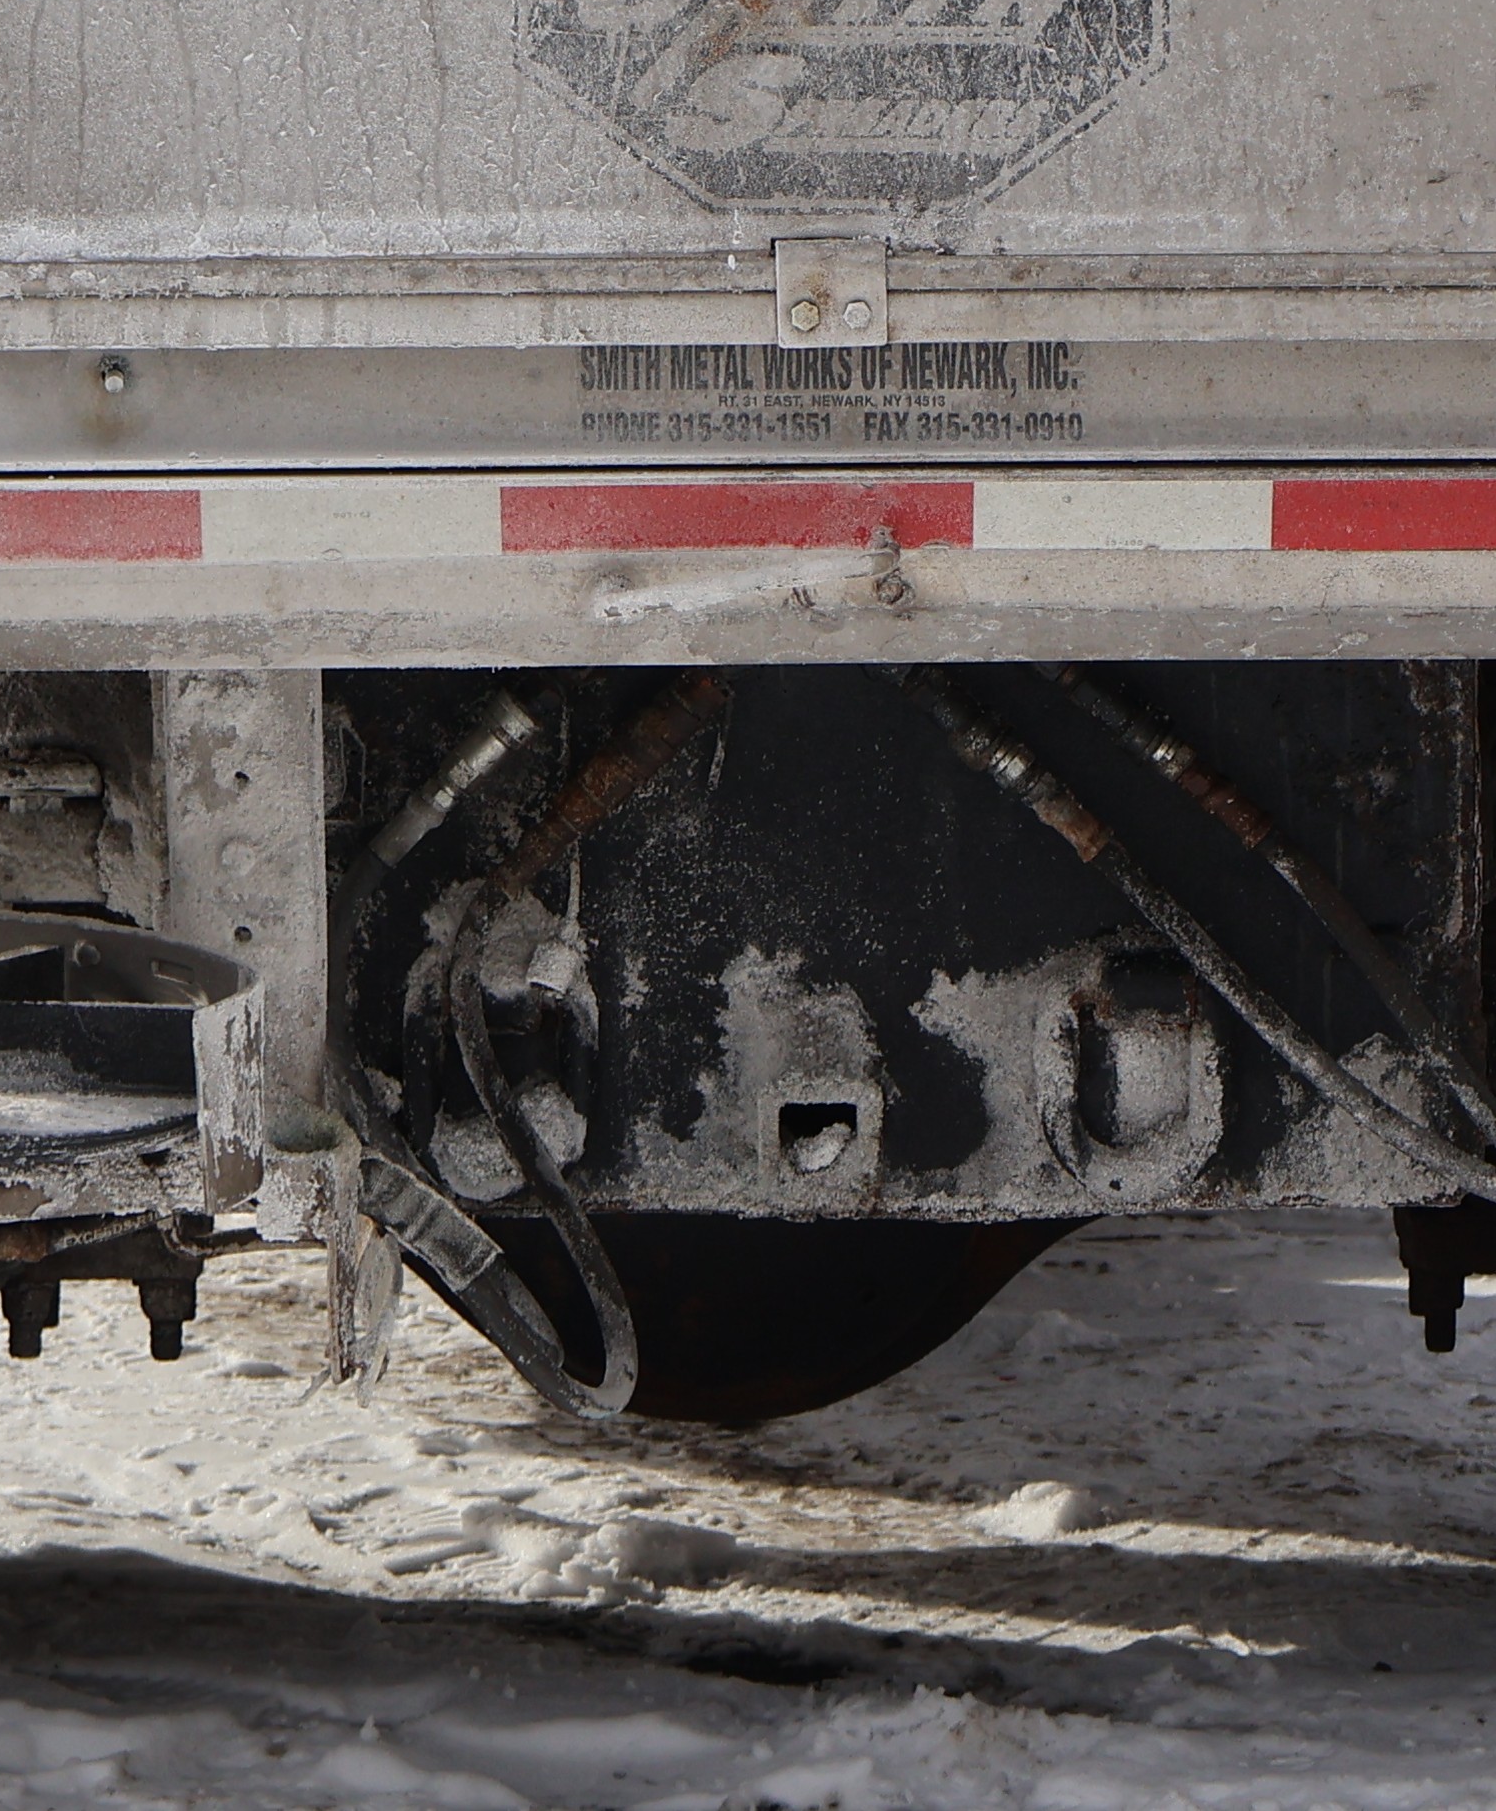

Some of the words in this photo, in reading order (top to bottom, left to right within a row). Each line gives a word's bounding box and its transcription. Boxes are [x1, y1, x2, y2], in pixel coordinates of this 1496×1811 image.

[581, 345, 660, 390] SMITH
[670, 345, 754, 390] METAL
[762, 344, 852, 389] WORKS
[861, 344, 893, 389] OF
[902, 342, 1017, 397] NEWARK,
[1028, 342, 1078, 390] INC.
[718, 395, 739, 407] RT.
[743, 395, 758, 407] 31
[764, 395, 804, 409] EAST,
[883, 395, 902, 407] NY
[906, 395, 946, 407] 14513
[581, 411, 660, 442] PHONE
[864, 411, 909, 441] FAX
